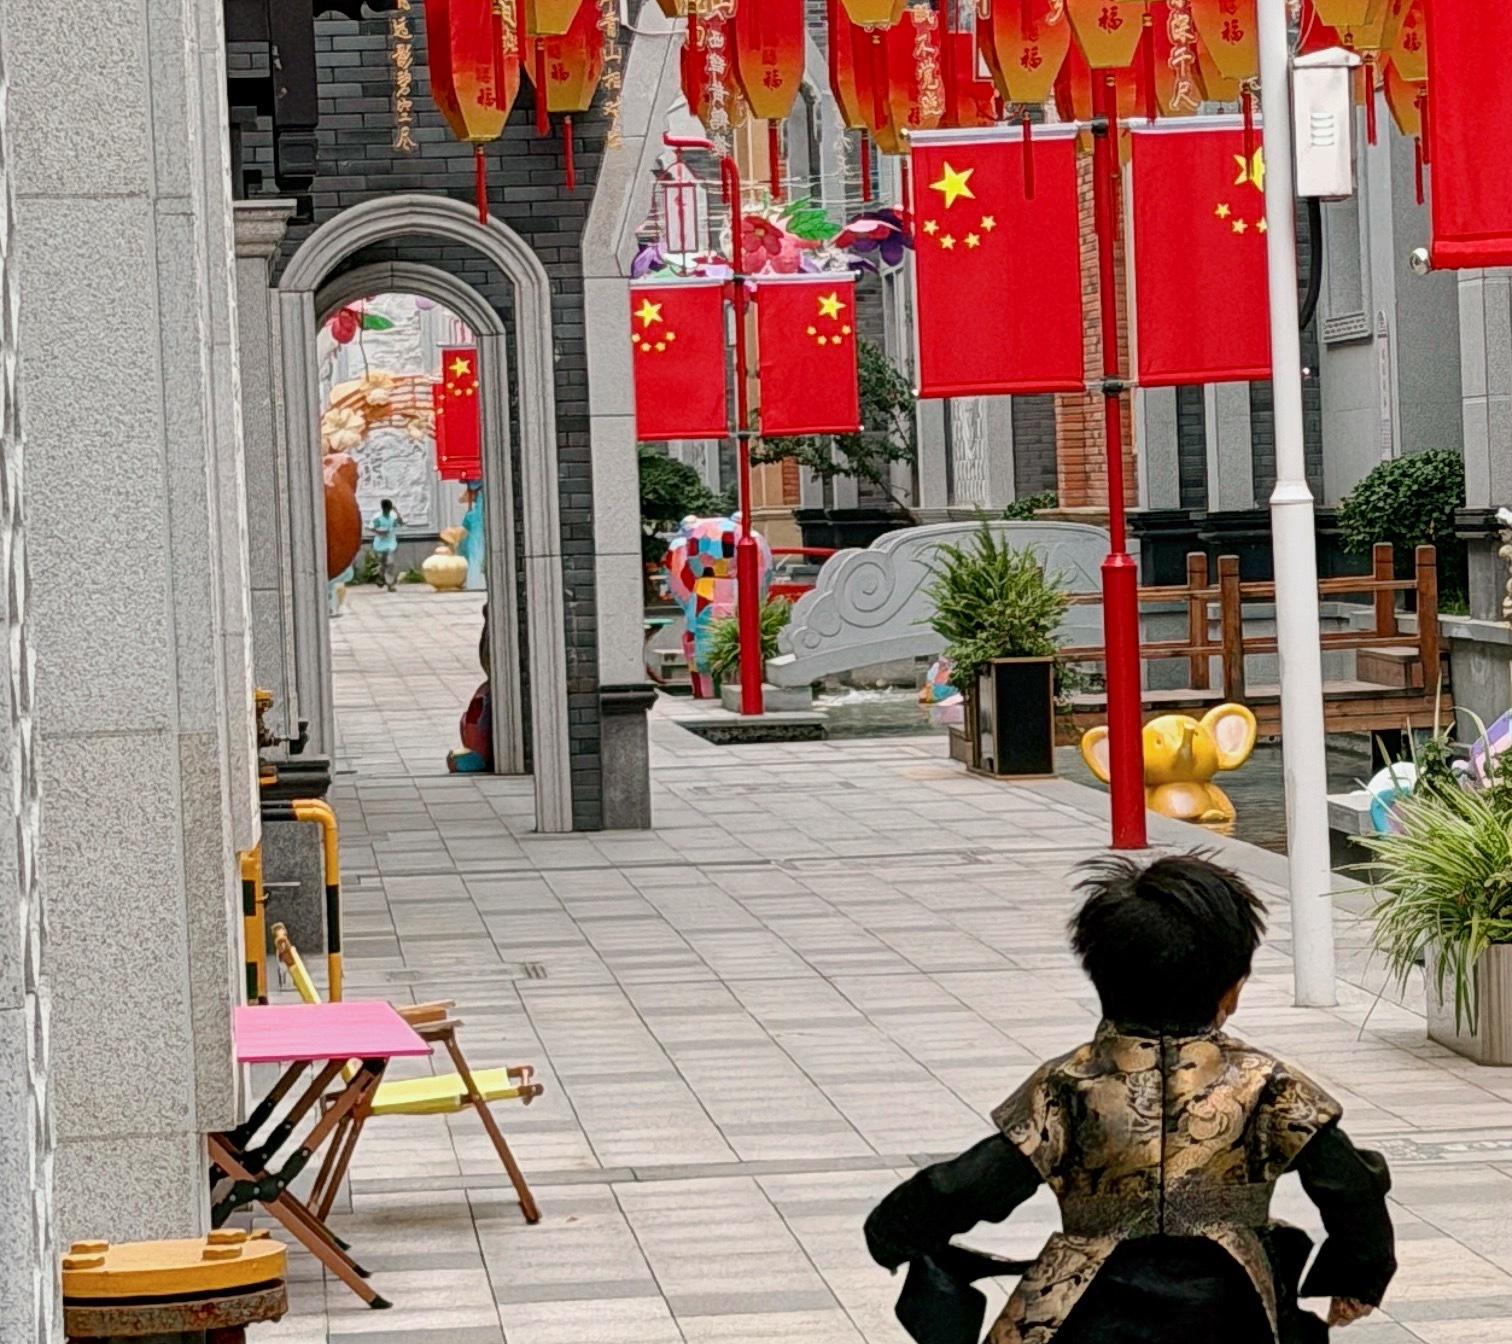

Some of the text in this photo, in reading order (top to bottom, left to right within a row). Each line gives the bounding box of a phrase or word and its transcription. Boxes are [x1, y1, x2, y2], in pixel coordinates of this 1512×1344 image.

[1098, 7, 1123, 34] 福
[1221, 19, 1245, 45] 福
[1020, 47, 1042, 72] 福
[551, 62, 569, 83] 福
[763, 69, 783, 91] 福
